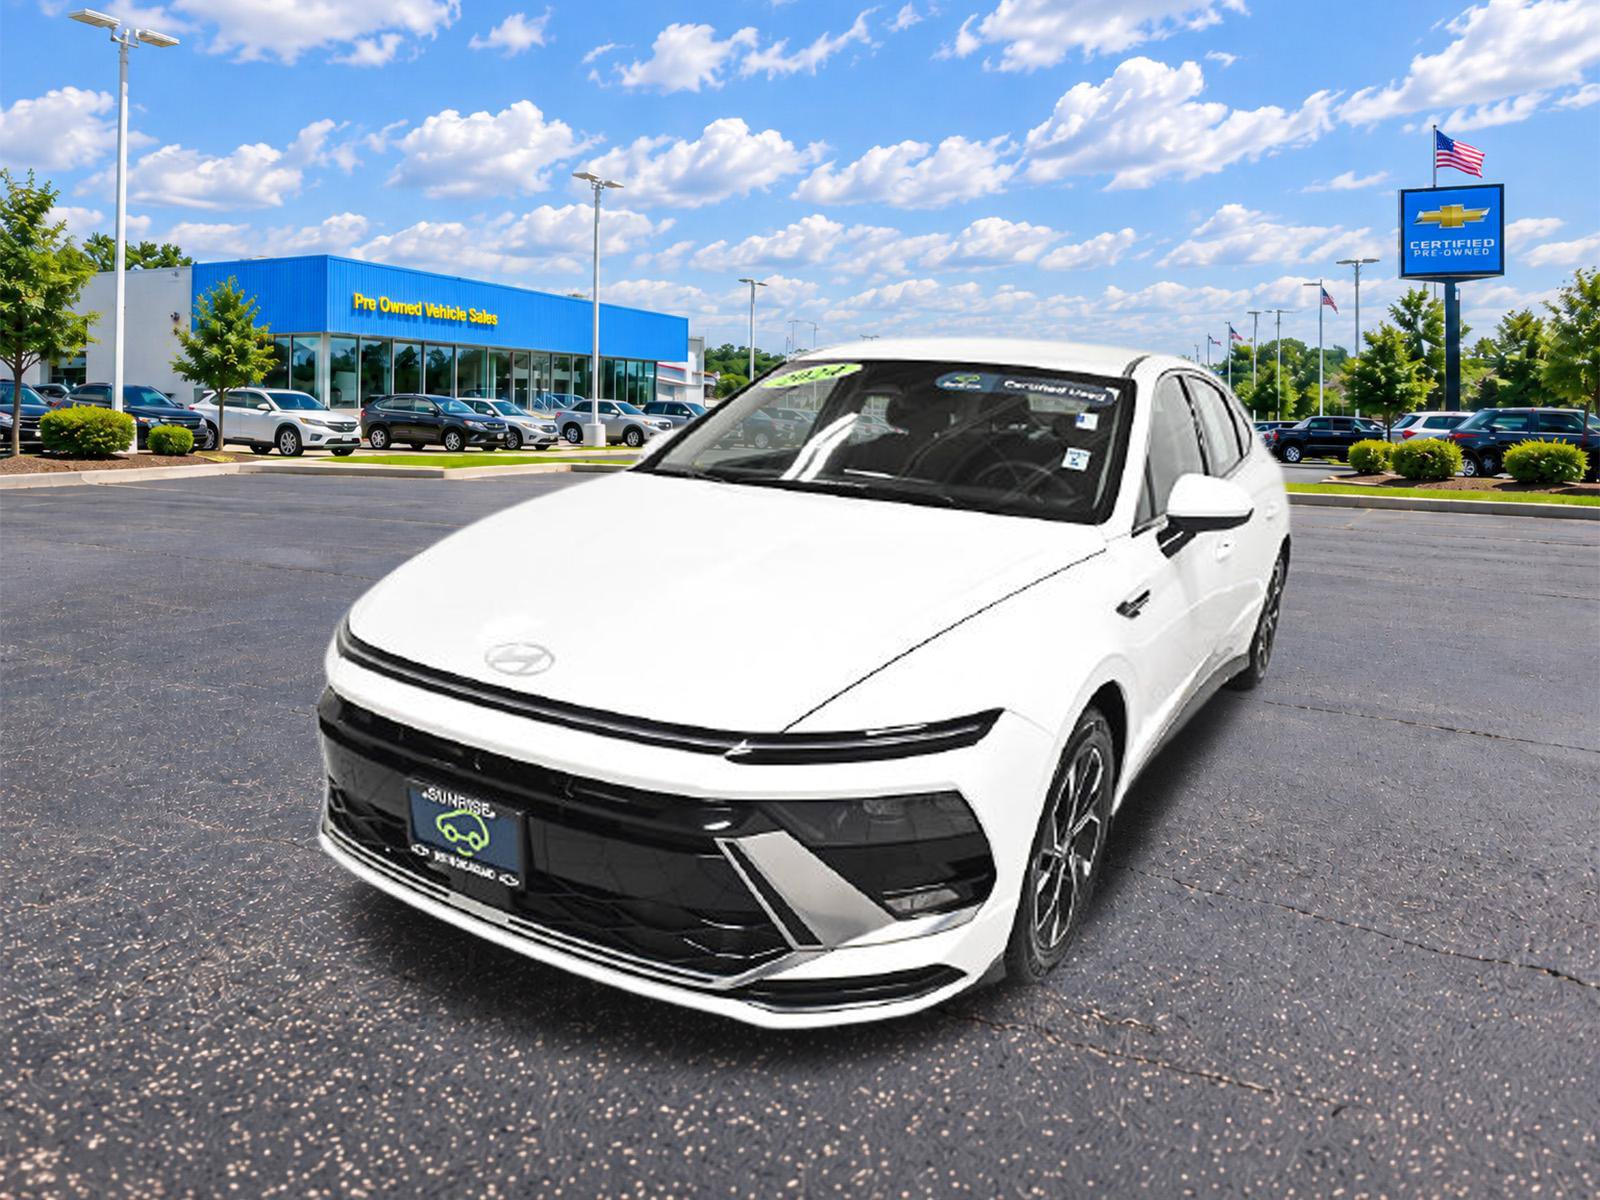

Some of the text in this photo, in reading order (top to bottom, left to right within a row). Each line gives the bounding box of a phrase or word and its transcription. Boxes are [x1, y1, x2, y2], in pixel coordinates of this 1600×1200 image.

[1410, 239, 1495, 249] CERTIFIED
[1414, 248, 1490, 257] PRE-OWNED
[353, 293, 498, 325] Pre Owned Vehicle Sales
[1004, 380, 1068, 394] Certified
[427, 787, 493, 818] SUNRISE
